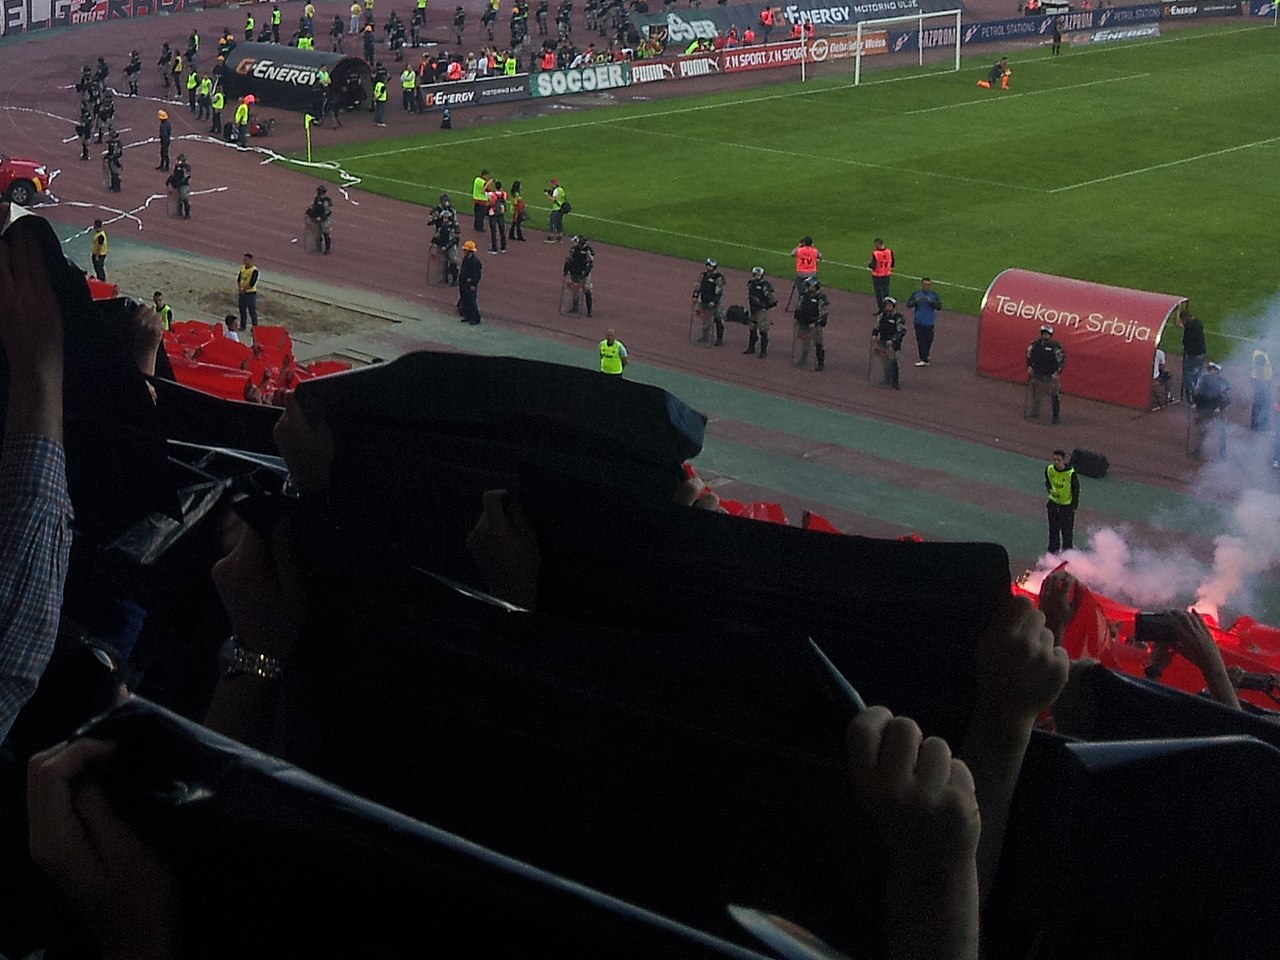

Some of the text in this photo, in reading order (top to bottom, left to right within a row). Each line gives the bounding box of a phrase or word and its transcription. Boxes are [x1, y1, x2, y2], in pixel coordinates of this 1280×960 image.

[854, 1, 896, 14] MOTORNO
[1006, 21, 1036, 34] STATIONS
[740, 52, 767, 67] SPORT
[632, 63, 665, 82] PUMA
[801, 257, 813, 265] TV
[996, 294, 1151, 343] Telekom Srbija
